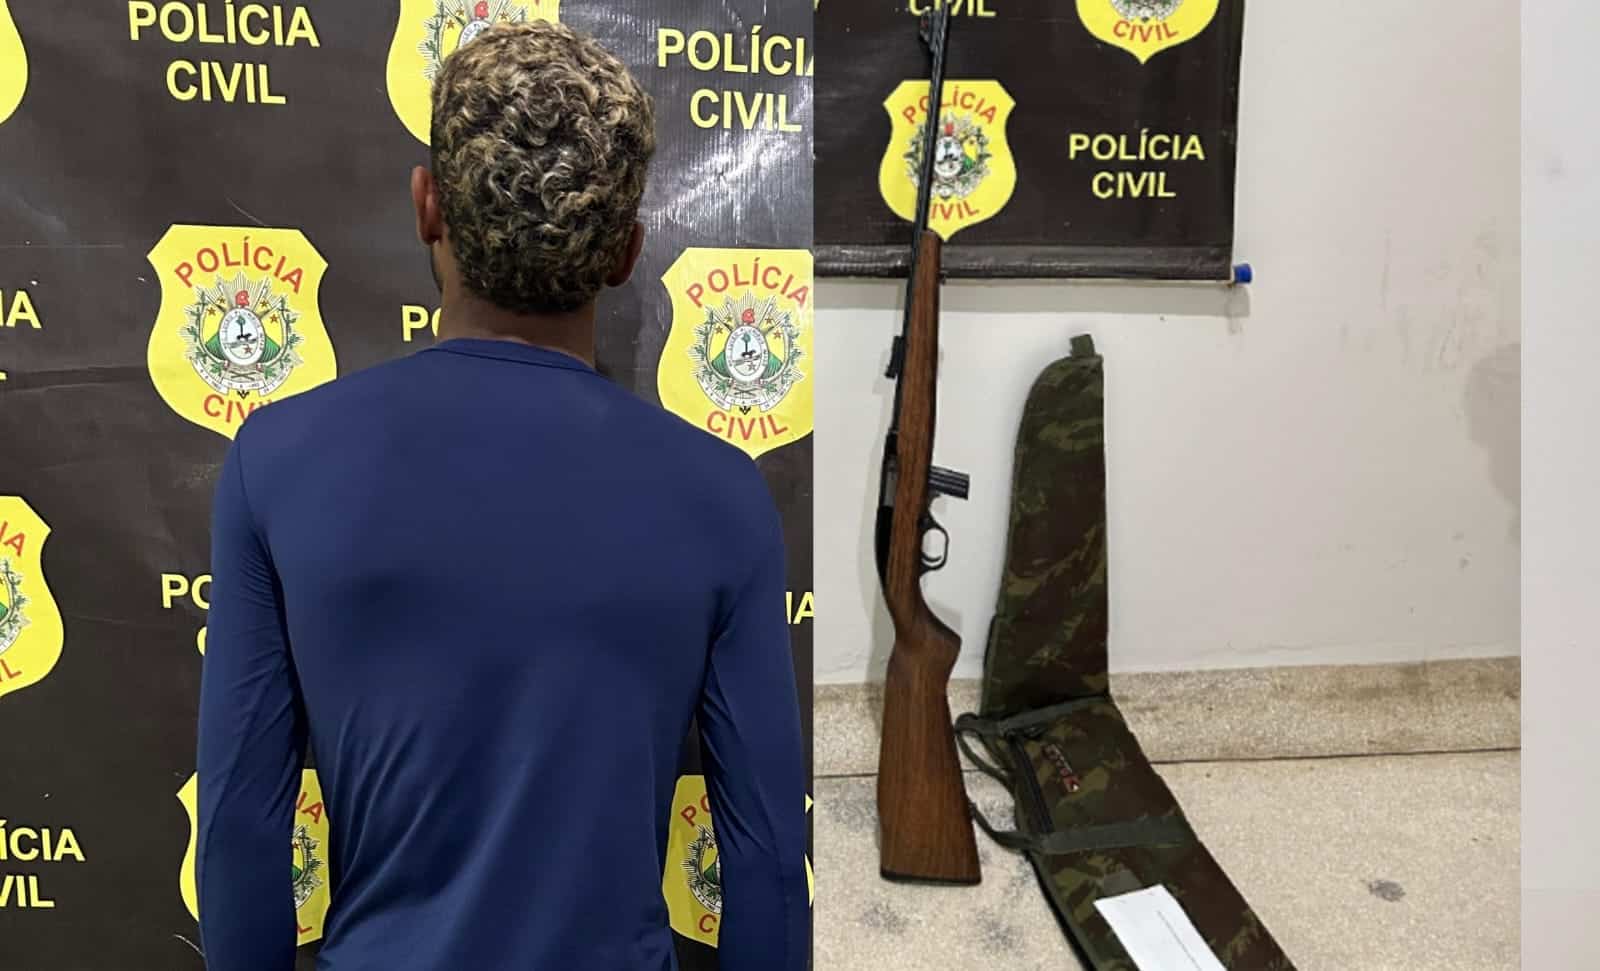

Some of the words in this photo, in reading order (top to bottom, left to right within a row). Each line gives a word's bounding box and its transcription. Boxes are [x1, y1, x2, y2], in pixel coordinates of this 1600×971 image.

[128, 0, 320, 47] POLÍCIA
[1113, 20, 1178, 43] CIVIL
[657, 25, 814, 77] POLÍCI
[166, 60, 287, 105] CIVIL
[689, 88, 802, 132] CIVIL
[1069, 128, 1205, 161] POLÍCIA
[1092, 171, 1177, 199] CIVIL
[931, 201, 980, 221] IVIL
[174, 236, 305, 293] POLÍCIA
[686, 257, 809, 308] POLÍCIA
[706, 410, 788, 440] CIVIL
